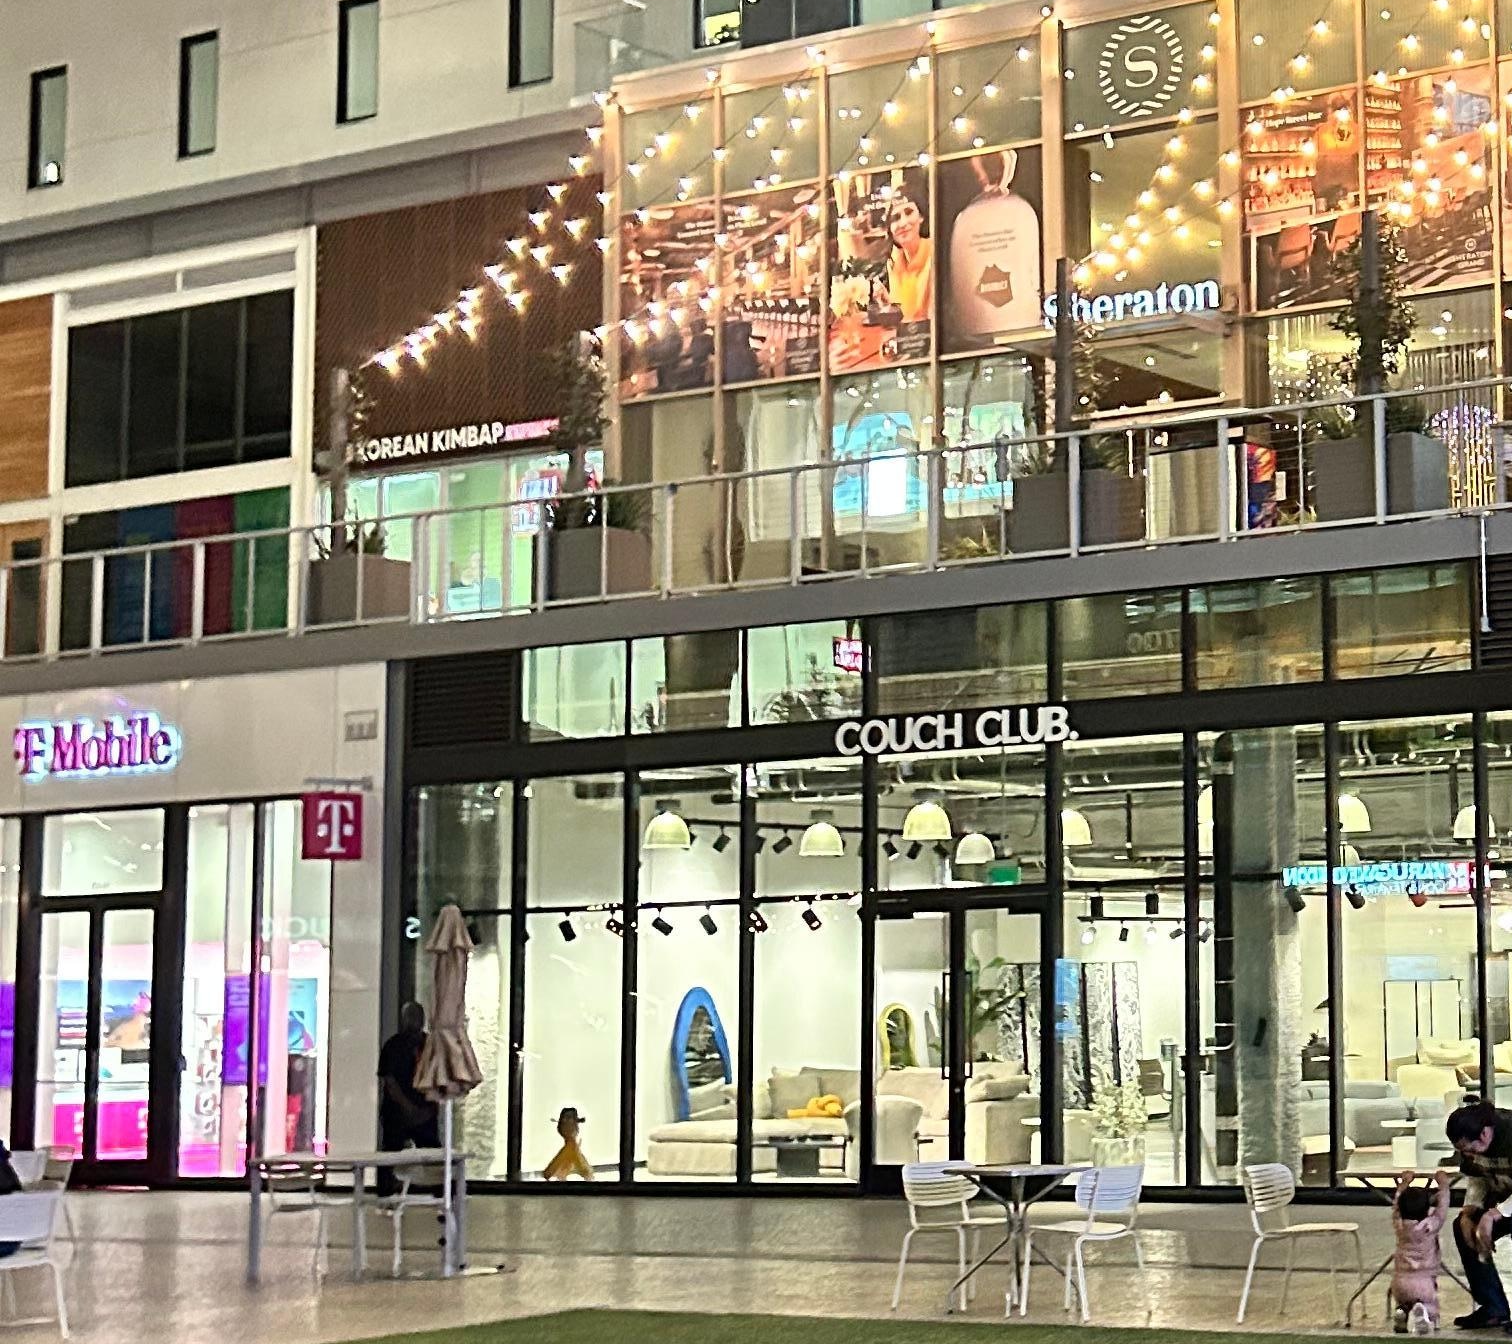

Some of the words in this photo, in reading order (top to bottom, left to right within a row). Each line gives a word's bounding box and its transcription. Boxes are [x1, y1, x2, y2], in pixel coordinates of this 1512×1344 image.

[1124, 45, 1159, 88] S
[432, 421, 504, 452] KIMBAP
[834, 712, 964, 756] COUCH
[975, 706, 1079, 747] CLUB.
[317, 799, 355, 853] T
